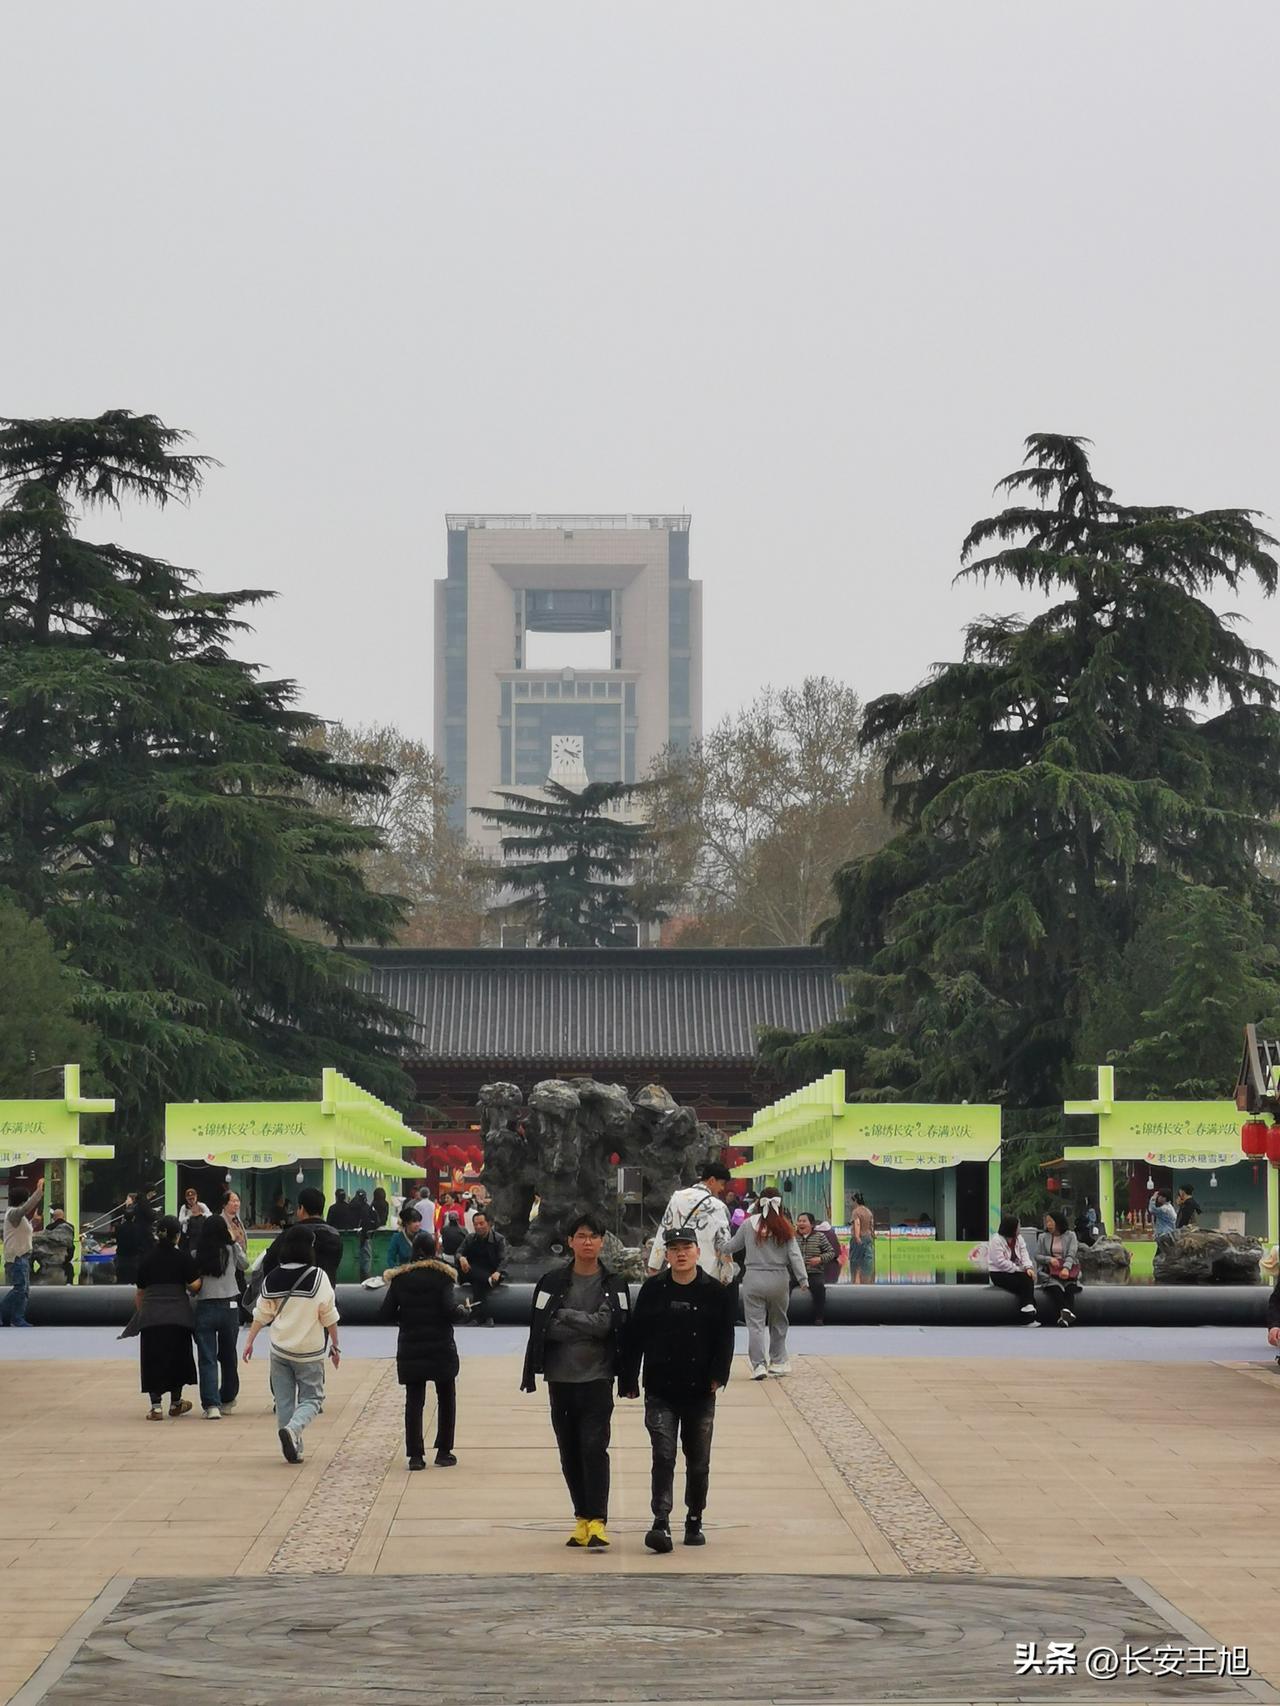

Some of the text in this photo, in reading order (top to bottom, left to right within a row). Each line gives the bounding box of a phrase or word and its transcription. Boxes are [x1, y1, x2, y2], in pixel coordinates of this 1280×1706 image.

[205, 1121, 305, 1136] 锦绣长安 春满兴庆
[871, 1123, 972, 1138] 锦绣长安 春满兴庆
[1142, 1121, 1240, 1136] 锦绣长安 春满兴庆
[882, 1154, 948, 1164] 网红一米大串
